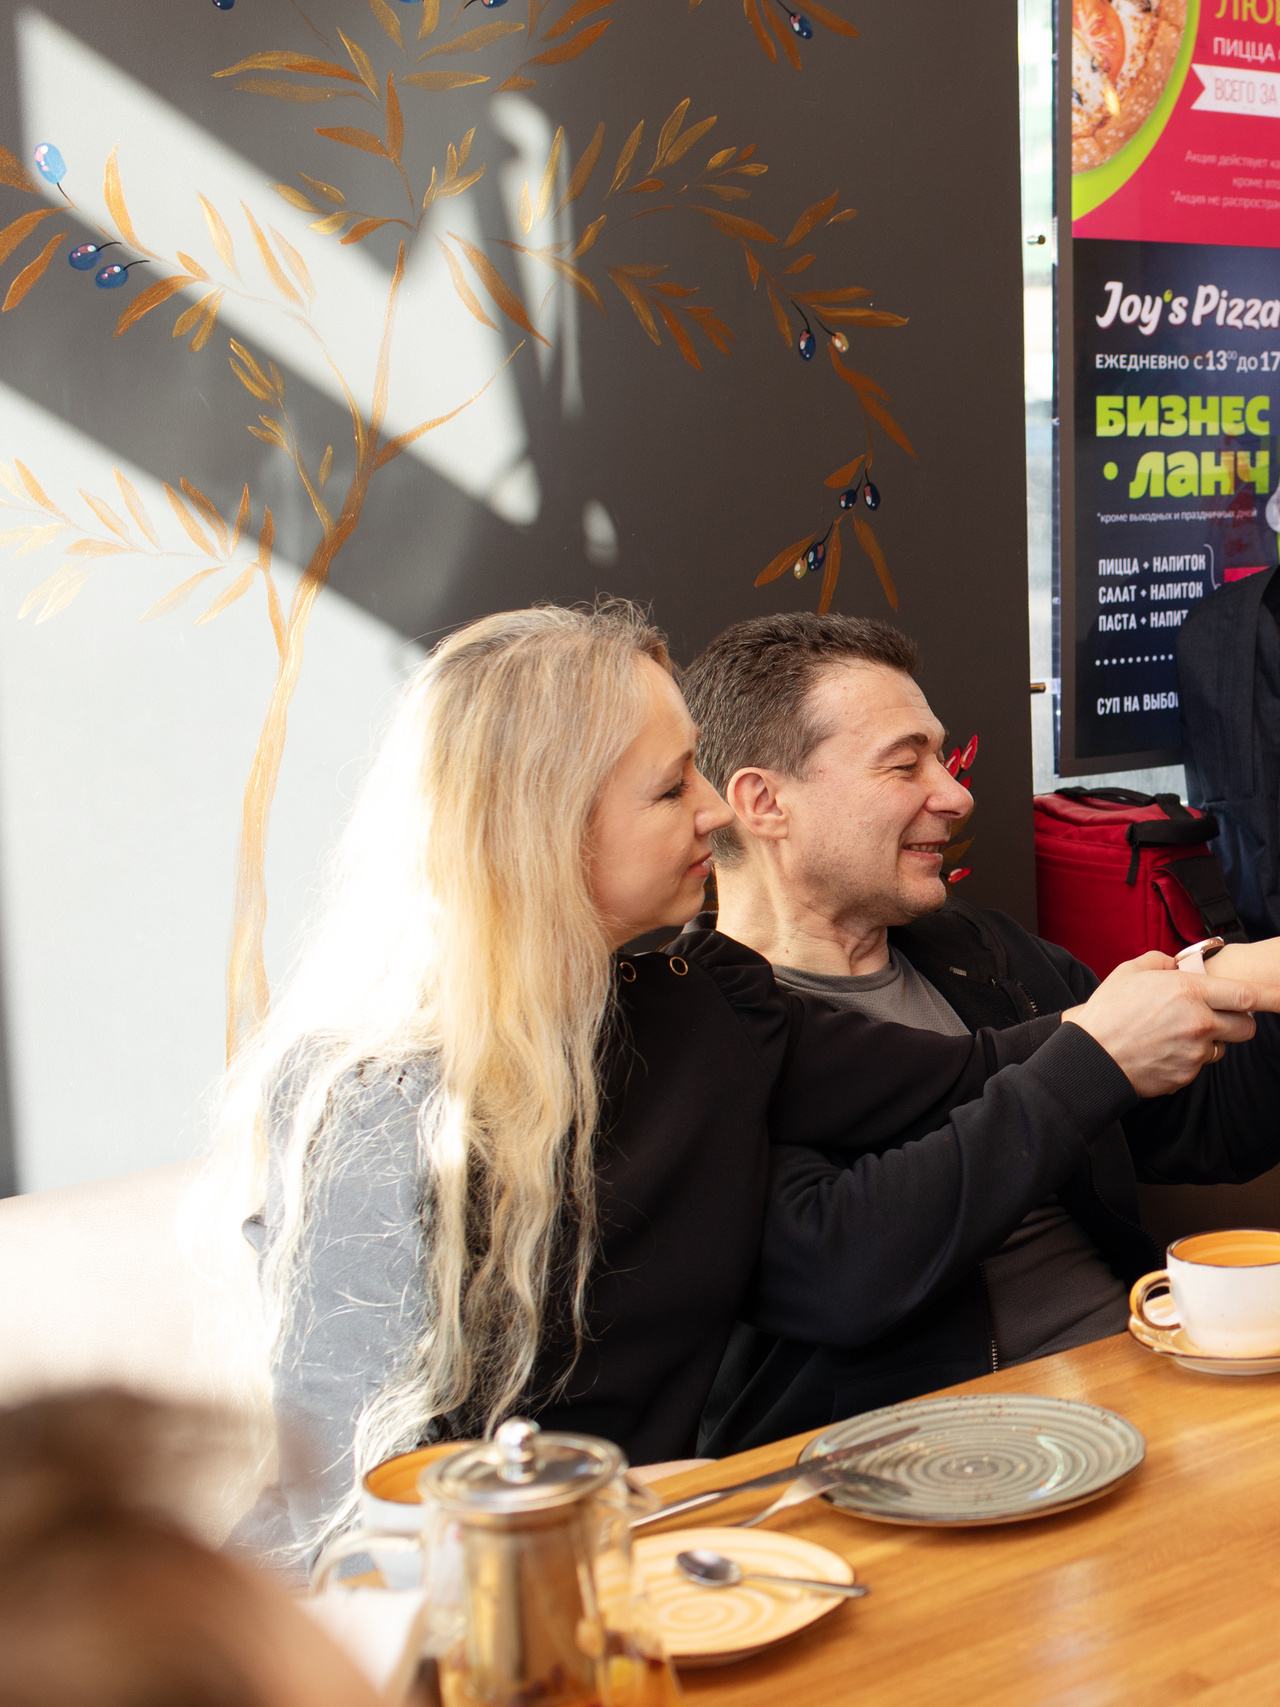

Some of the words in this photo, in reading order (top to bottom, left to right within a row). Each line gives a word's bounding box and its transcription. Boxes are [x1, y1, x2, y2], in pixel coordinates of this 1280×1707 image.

[1213, 36, 1276, 64] ПИЦЦА
[1214, 77, 1256, 104] ВСЕГО
[1259, 82, 1279, 107] ЗА
[1184, 149, 1218, 164] Акция
[1095, 280, 1189, 337] Joy's
[1095, 353, 1190, 372] ЕЖЕДНЕВНО
[1096, 395, 1270, 437] БИЗНЕС
[1129, 511, 1173, 523] выходных
[1174, 511, 1181, 521] и
[1181, 508, 1235, 522] праздничных
[1235, 506, 1258, 520] дней
[1098, 557, 1140, 576] ПИЦЦА
[1152, 553, 1206, 573] НАПИТОК
[1098, 584, 1137, 605] САЛАТ
[1150, 581, 1203, 601] НАПИТОК
[1098, 613, 1137, 632] ПАСТА
[1096, 697, 1121, 716] СУП
[1123, 695, 1140, 712] НА
